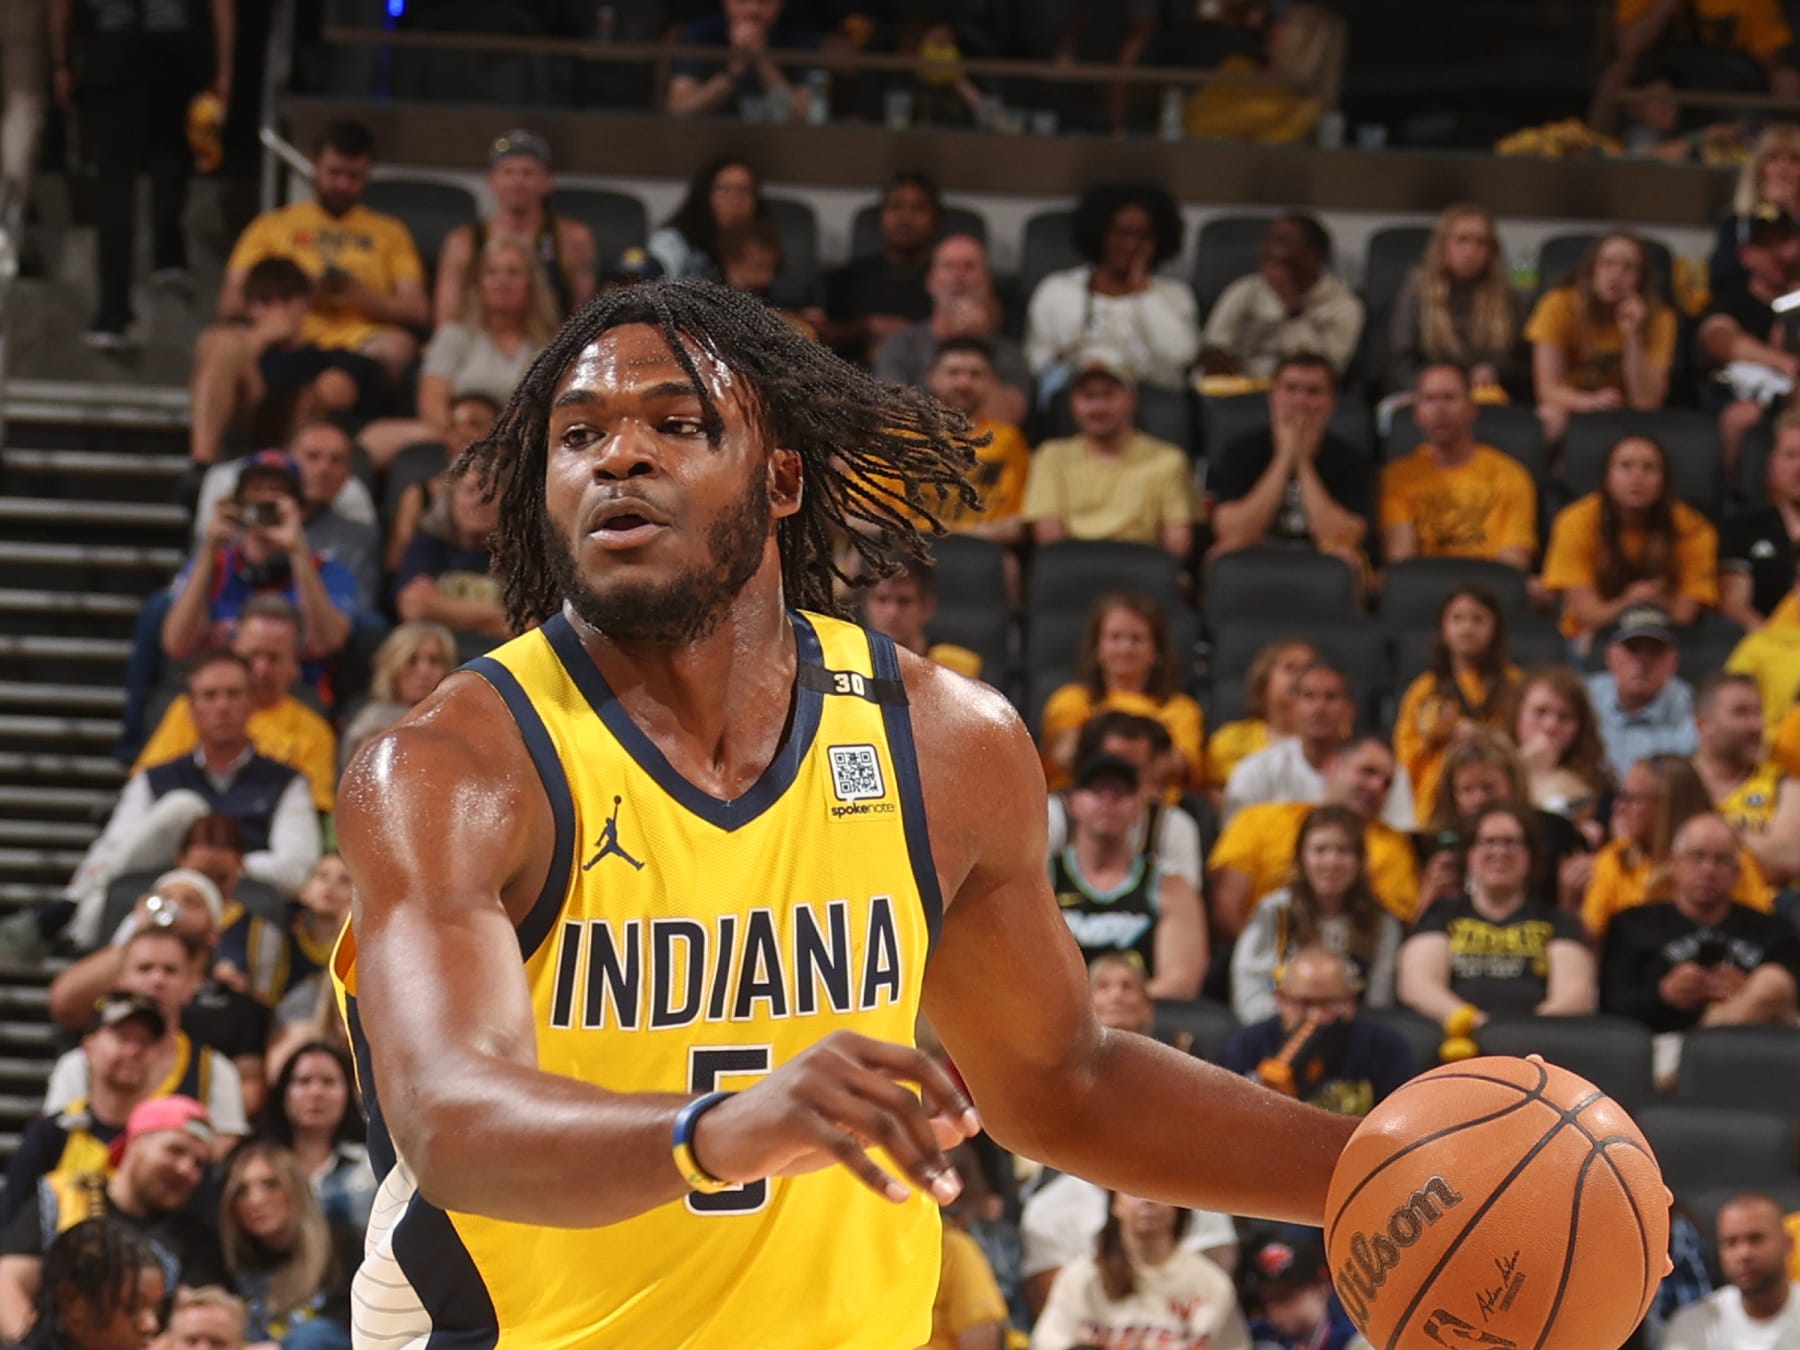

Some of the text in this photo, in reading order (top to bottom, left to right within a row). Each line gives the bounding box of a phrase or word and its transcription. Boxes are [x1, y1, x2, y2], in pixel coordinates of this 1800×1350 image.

[833, 673, 865, 697] 30
[831, 802, 895, 819] spokenote
[550, 895, 902, 1030] INDIANA
